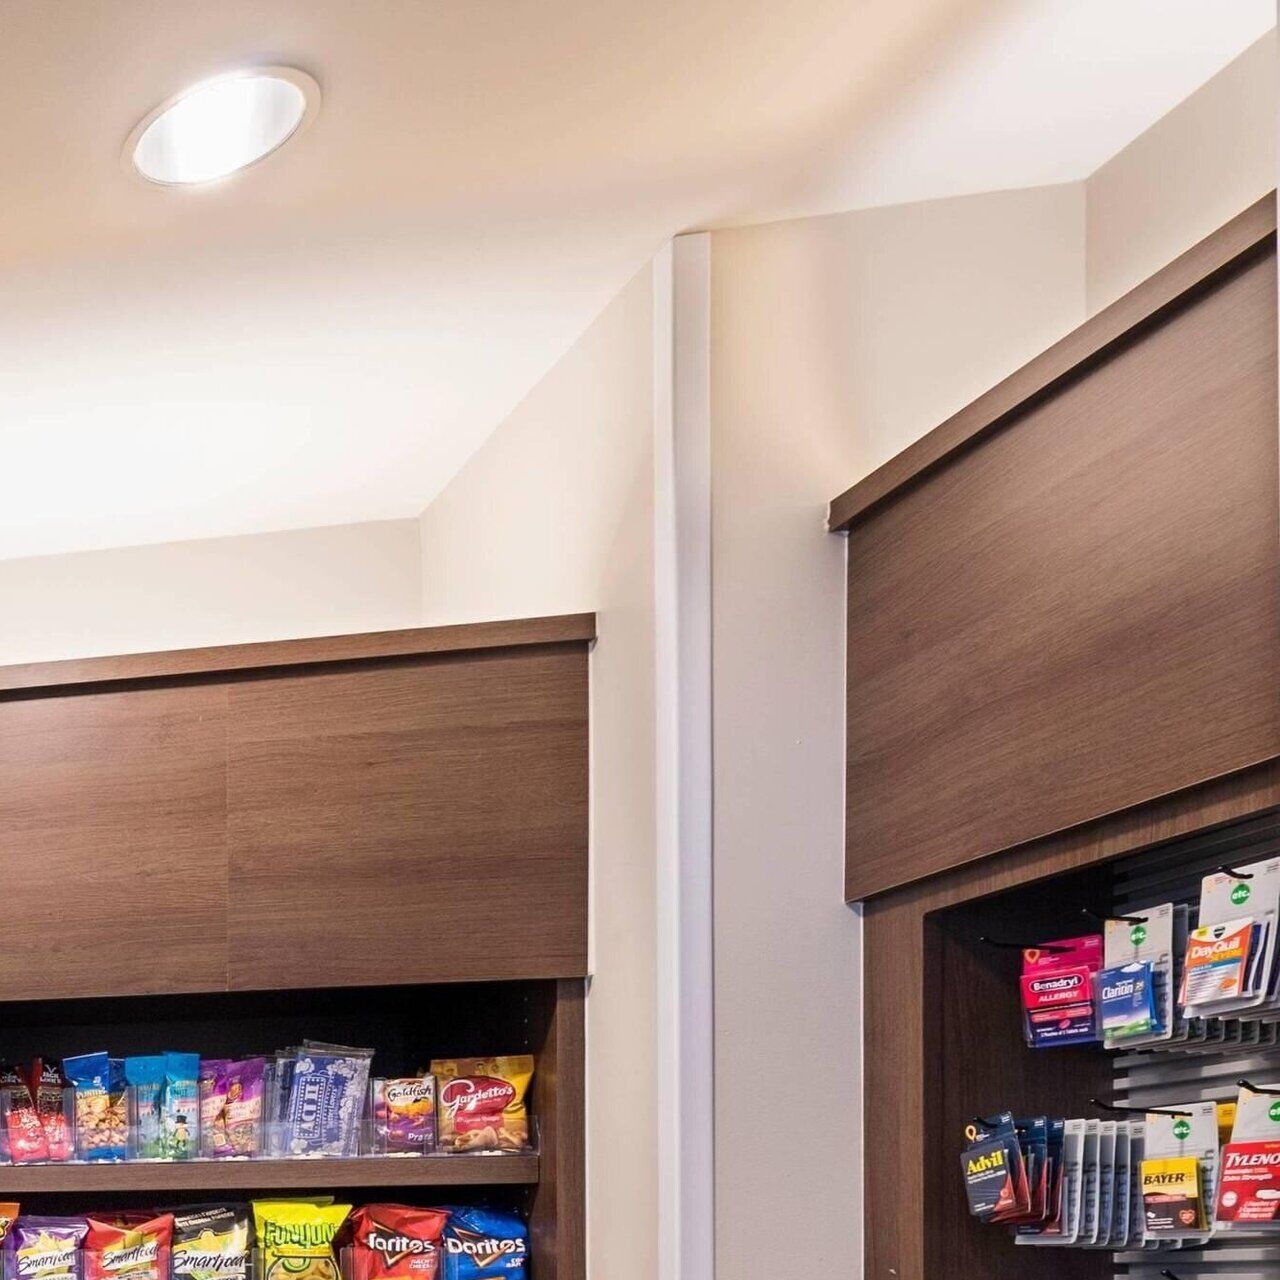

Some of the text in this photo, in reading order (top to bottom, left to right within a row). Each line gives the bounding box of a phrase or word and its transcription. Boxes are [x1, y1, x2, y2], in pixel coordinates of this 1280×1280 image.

[1231, 888, 1250, 900] etc.
[1131, 932, 1147, 942] etc.
[1191, 936, 1241, 959] DayQuil
[1032, 976, 1079, 992] Benadryl
[1102, 982, 1134, 1000] Claritin
[1038, 990, 1080, 1003] ALLERGY
[387, 1085, 432, 1101] Goldfish
[442, 1079, 514, 1117] Gardetto's
[300, 1103, 318, 1134] ACT
[1173, 1126, 1190, 1135] etc.
[966, 1150, 1004, 1175] Advil
[1225, 1152, 1280, 1169] TYLENO
[1143, 1172, 1186, 1186] BAYER
[446, 1237, 526, 1255] Doritos
[102, 1242, 160, 1268] Smartfood
[173, 1249, 244, 1272] Smartfood
